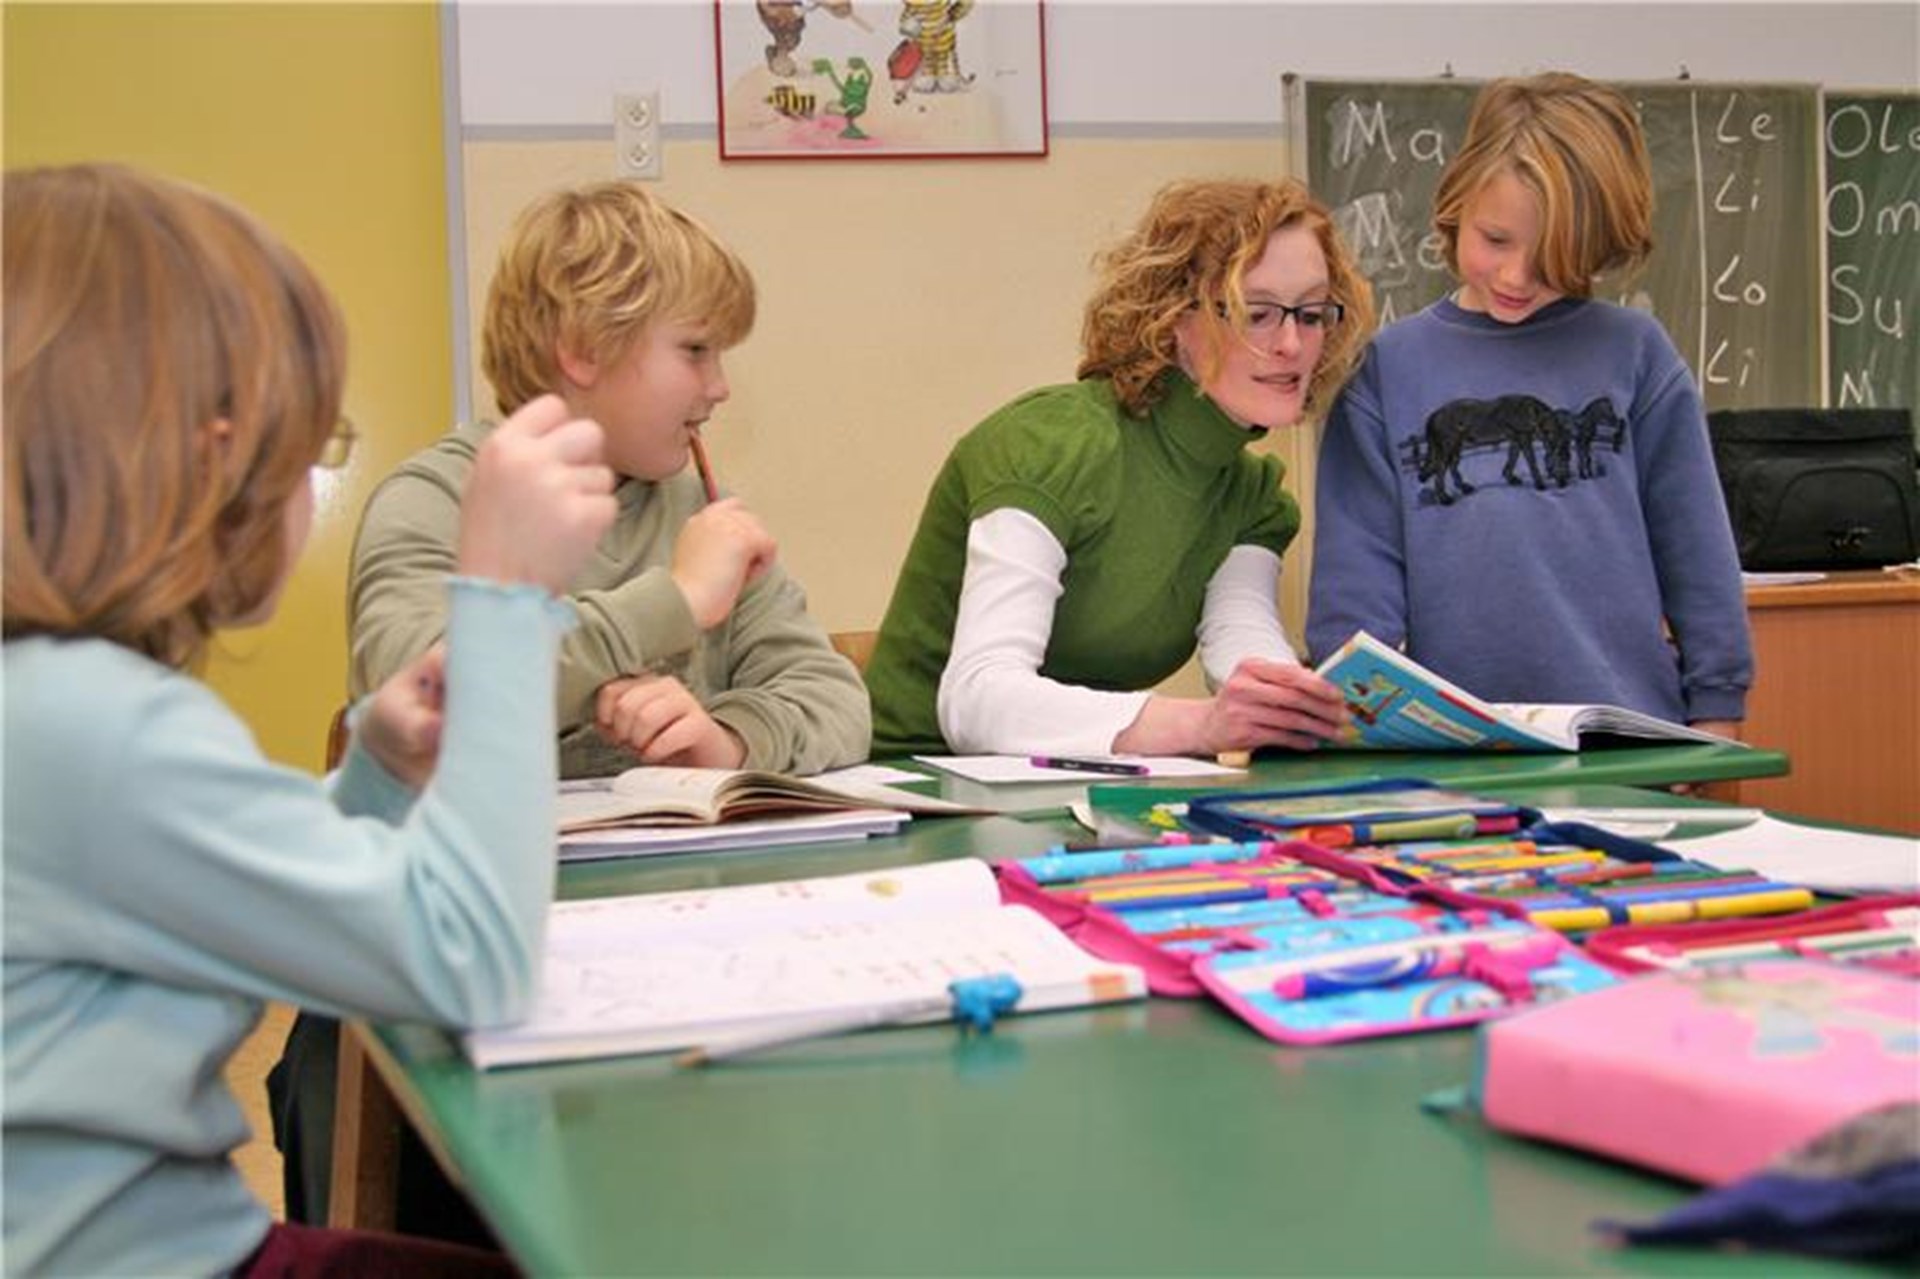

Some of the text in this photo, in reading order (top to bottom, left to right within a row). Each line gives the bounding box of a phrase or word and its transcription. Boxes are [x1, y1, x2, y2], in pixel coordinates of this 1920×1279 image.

[1343, 100, 1445, 166] Ma
[1717, 93, 1776, 143] Le
[1715, 173, 1759, 212] Li
[1352, 193, 1447, 270] Me
[1713, 256, 1766, 305] Lo
[1829, 265, 1903, 339] Su
[1706, 339, 1753, 388] Li
